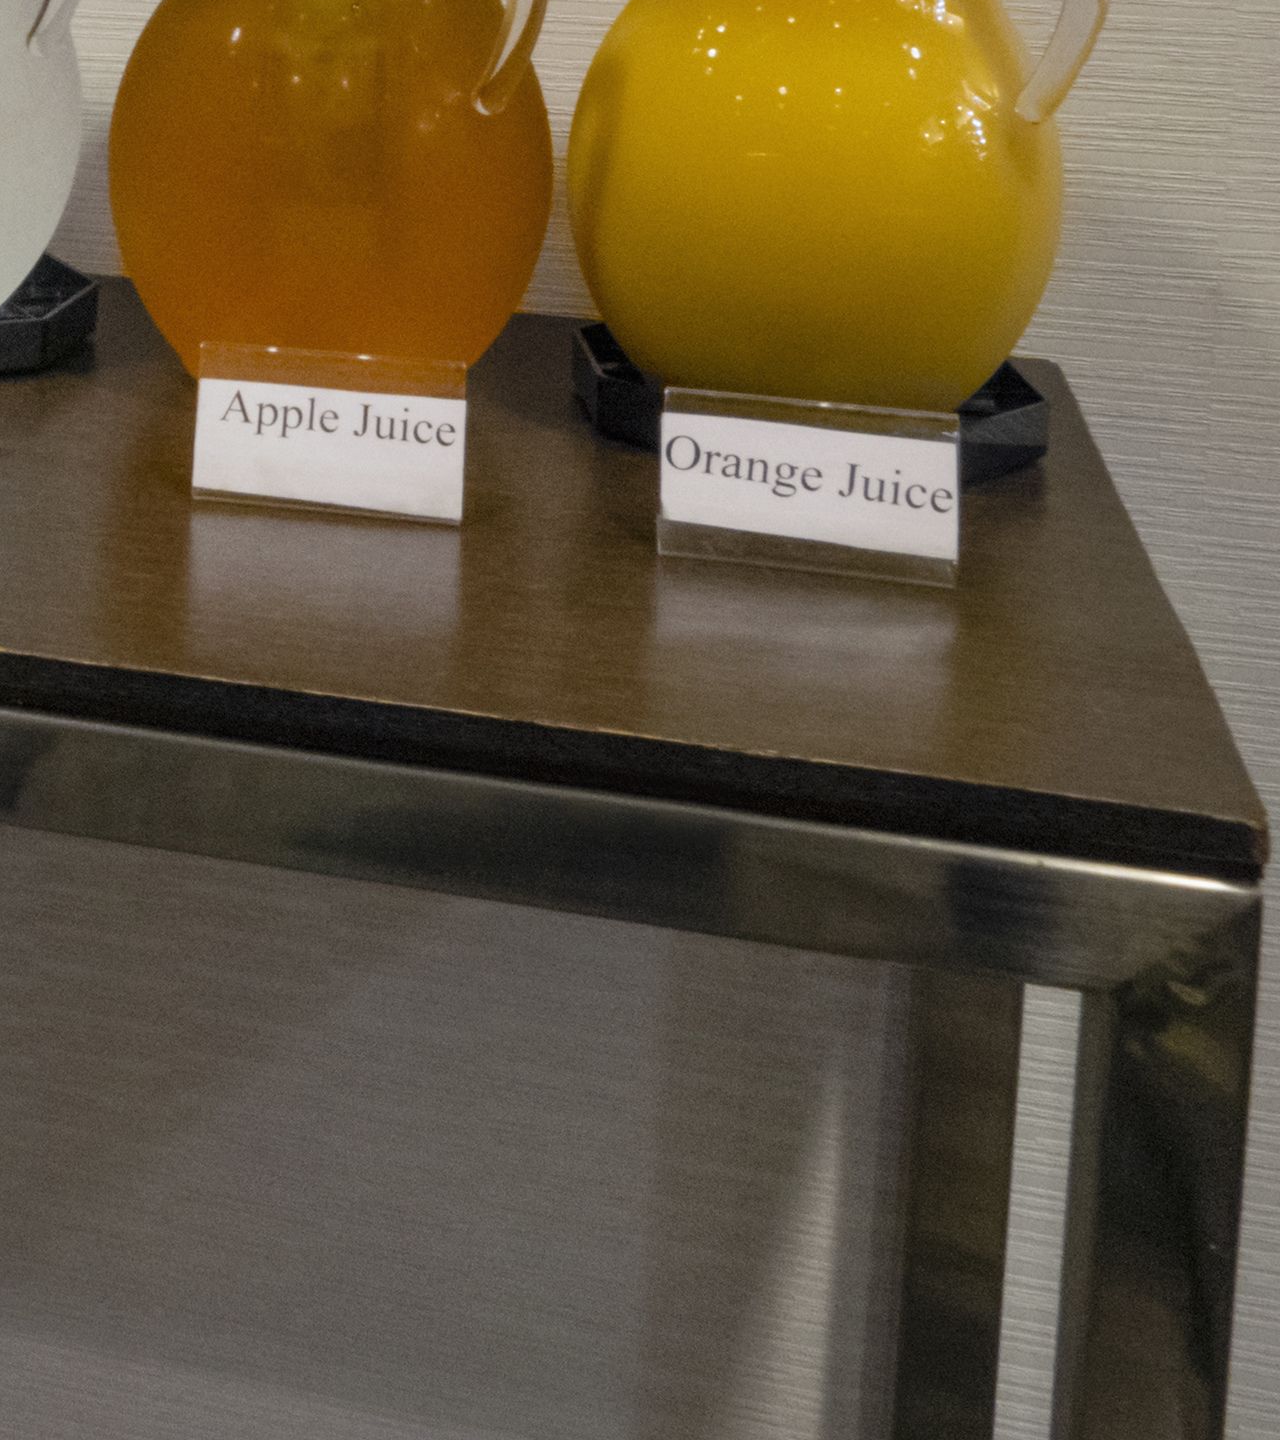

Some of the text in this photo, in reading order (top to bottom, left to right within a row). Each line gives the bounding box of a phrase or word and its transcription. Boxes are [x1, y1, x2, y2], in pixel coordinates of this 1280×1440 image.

[220, 390, 457, 447] Apple Juice
[665, 434, 954, 514] Orange Juice
